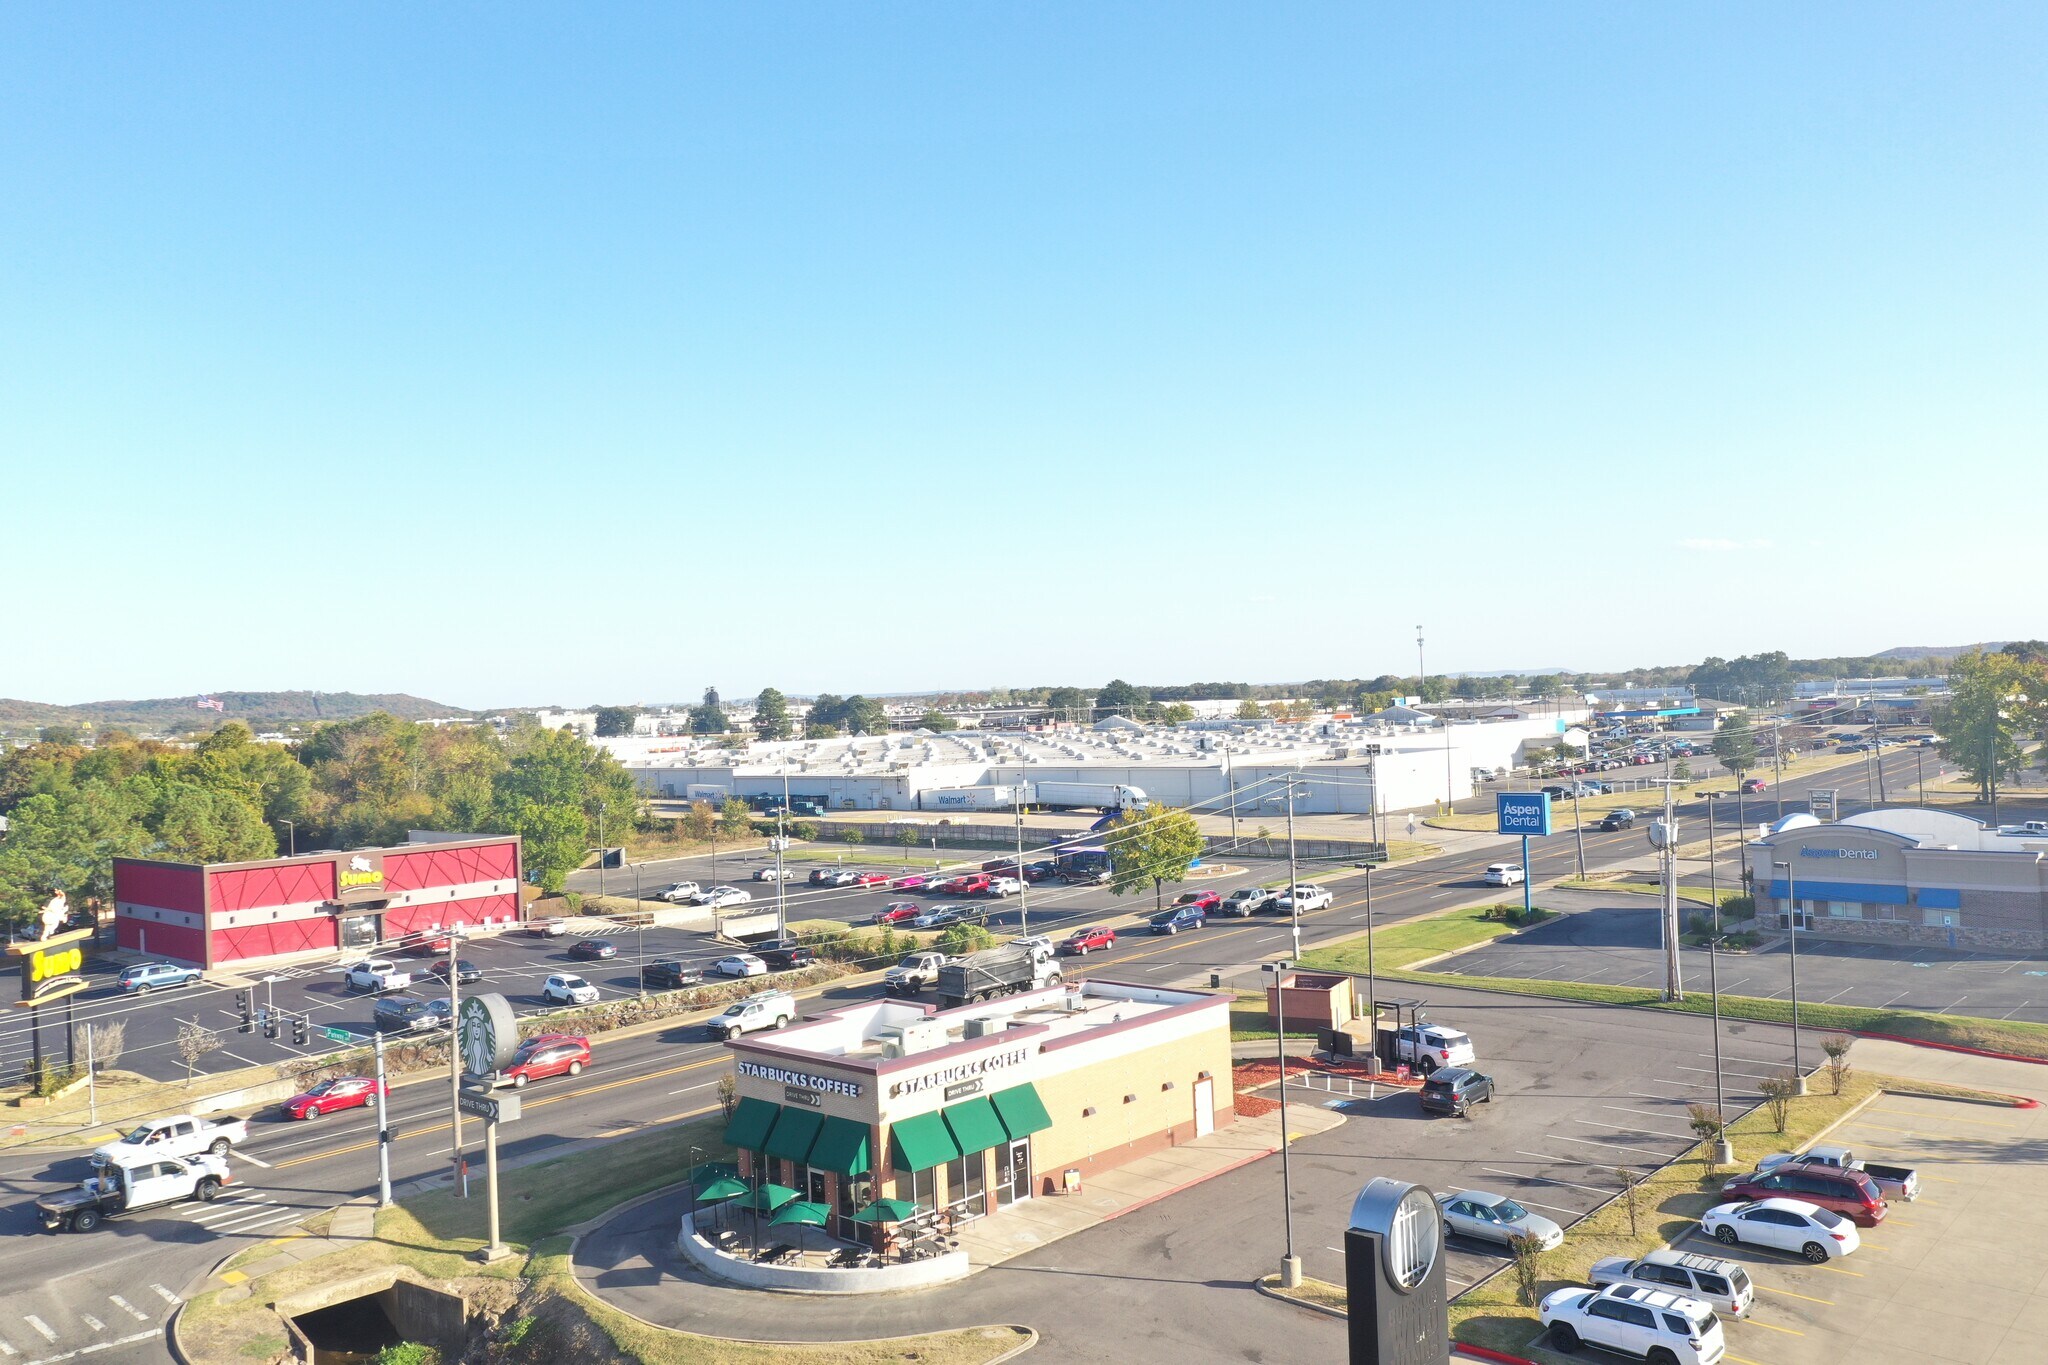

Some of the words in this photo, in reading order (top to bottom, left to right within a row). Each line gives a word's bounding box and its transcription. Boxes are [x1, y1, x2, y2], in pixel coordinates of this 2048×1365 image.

[938, 795, 967, 804] Walmart
[1503, 801, 1540, 816] Aspen
[1504, 815, 1540, 827] Dental
[1839, 848, 1878, 860] Dental
[897, 1060, 983, 1096] STARBUCKS
[982, 1048, 1028, 1073] COFFEE
[738, 1061, 807, 1087] STARBUCKS
[809, 1076, 858, 1098] COFFEE
[785, 1091, 799, 1099] DRIVE
[799, 1093, 810, 1102] THRU
[947, 1086, 962, 1097] DRIVE
[962, 1083, 975, 1092] THRU
[459, 1097, 475, 1109] DRIVE
[475, 1101, 490, 1112] THRU
